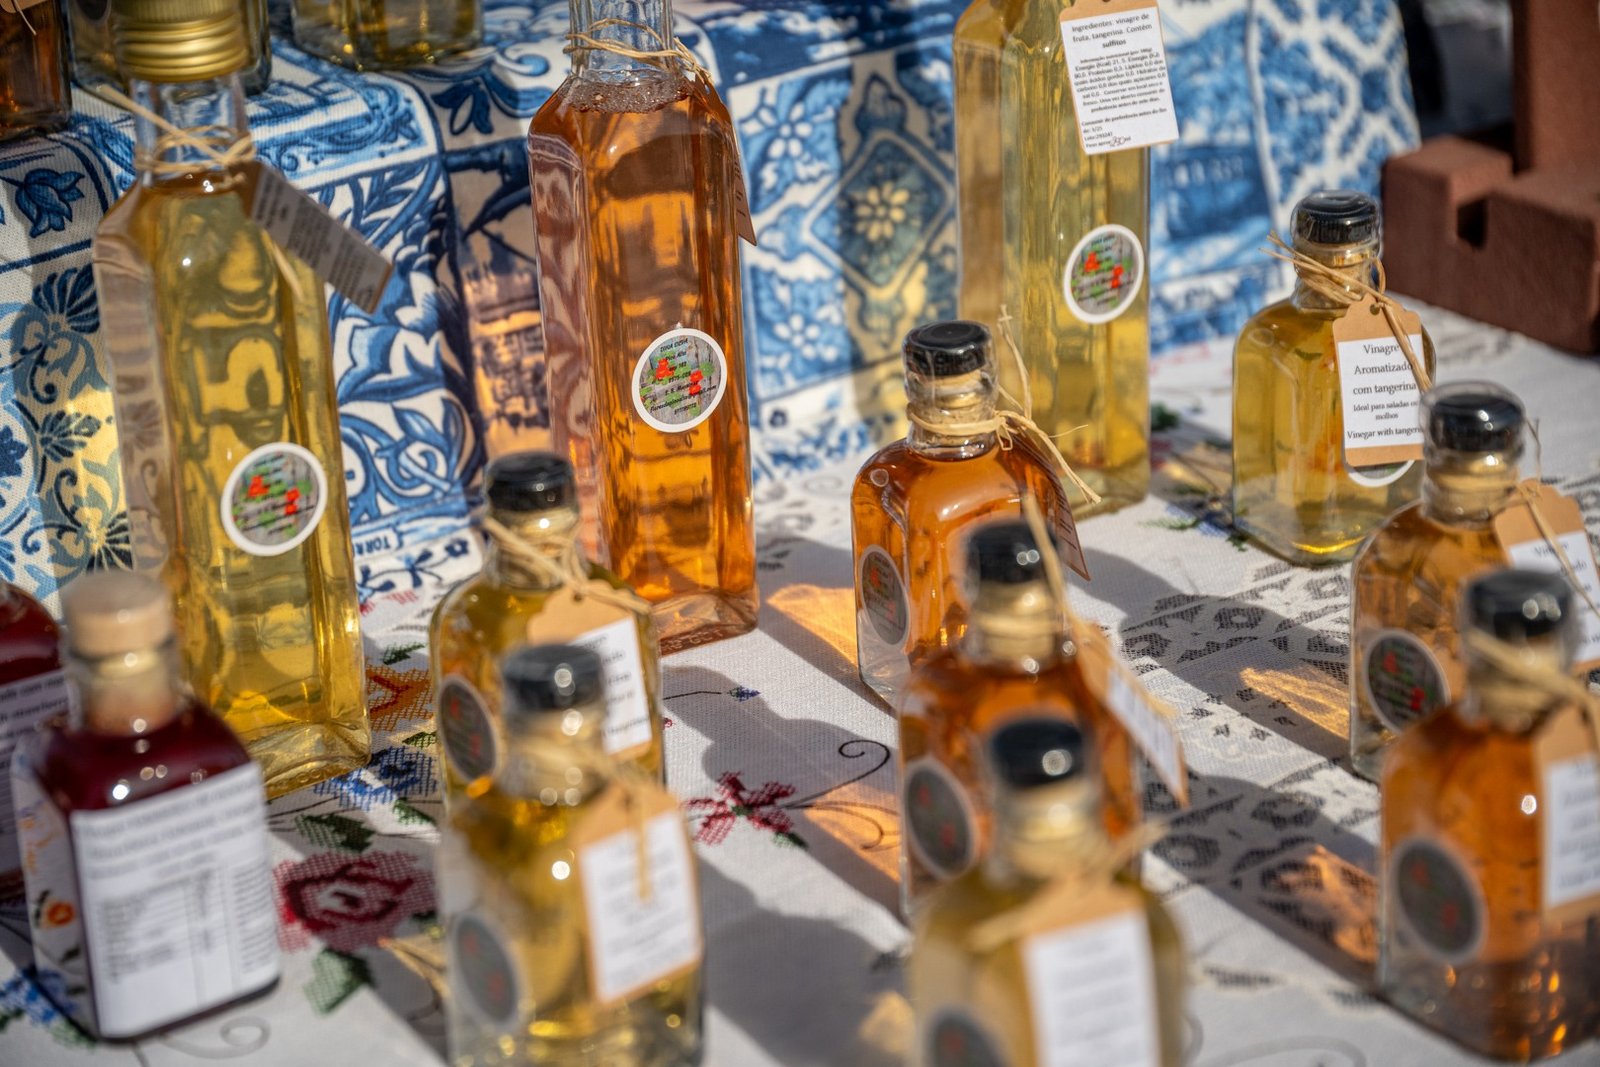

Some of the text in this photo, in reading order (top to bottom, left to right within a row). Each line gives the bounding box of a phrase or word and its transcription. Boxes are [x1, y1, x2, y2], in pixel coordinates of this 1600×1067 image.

[1072, 20, 1114, 33] Ingredientes:
[1116, 15, 1140, 26] vinagre
[1092, 28, 1125, 40] tangerina.
[1126, 24, 1153, 34] Contém
[1102, 39, 1127, 48] sulfitos
[1363, 344, 1400, 355] Vinagre
[1354, 361, 1412, 375] Aromatizado
[1352, 381, 1417, 395] com tangerina
[1353, 403, 1369, 412] Ideal
[1370, 403, 1385, 412] para
[1386, 400, 1409, 409] saladas
[1375, 412, 1399, 420] molhos
[1347, 430, 1375, 440] Vinegar
[1377, 428, 1394, 436] with
[354, 535, 391, 556] TORR
